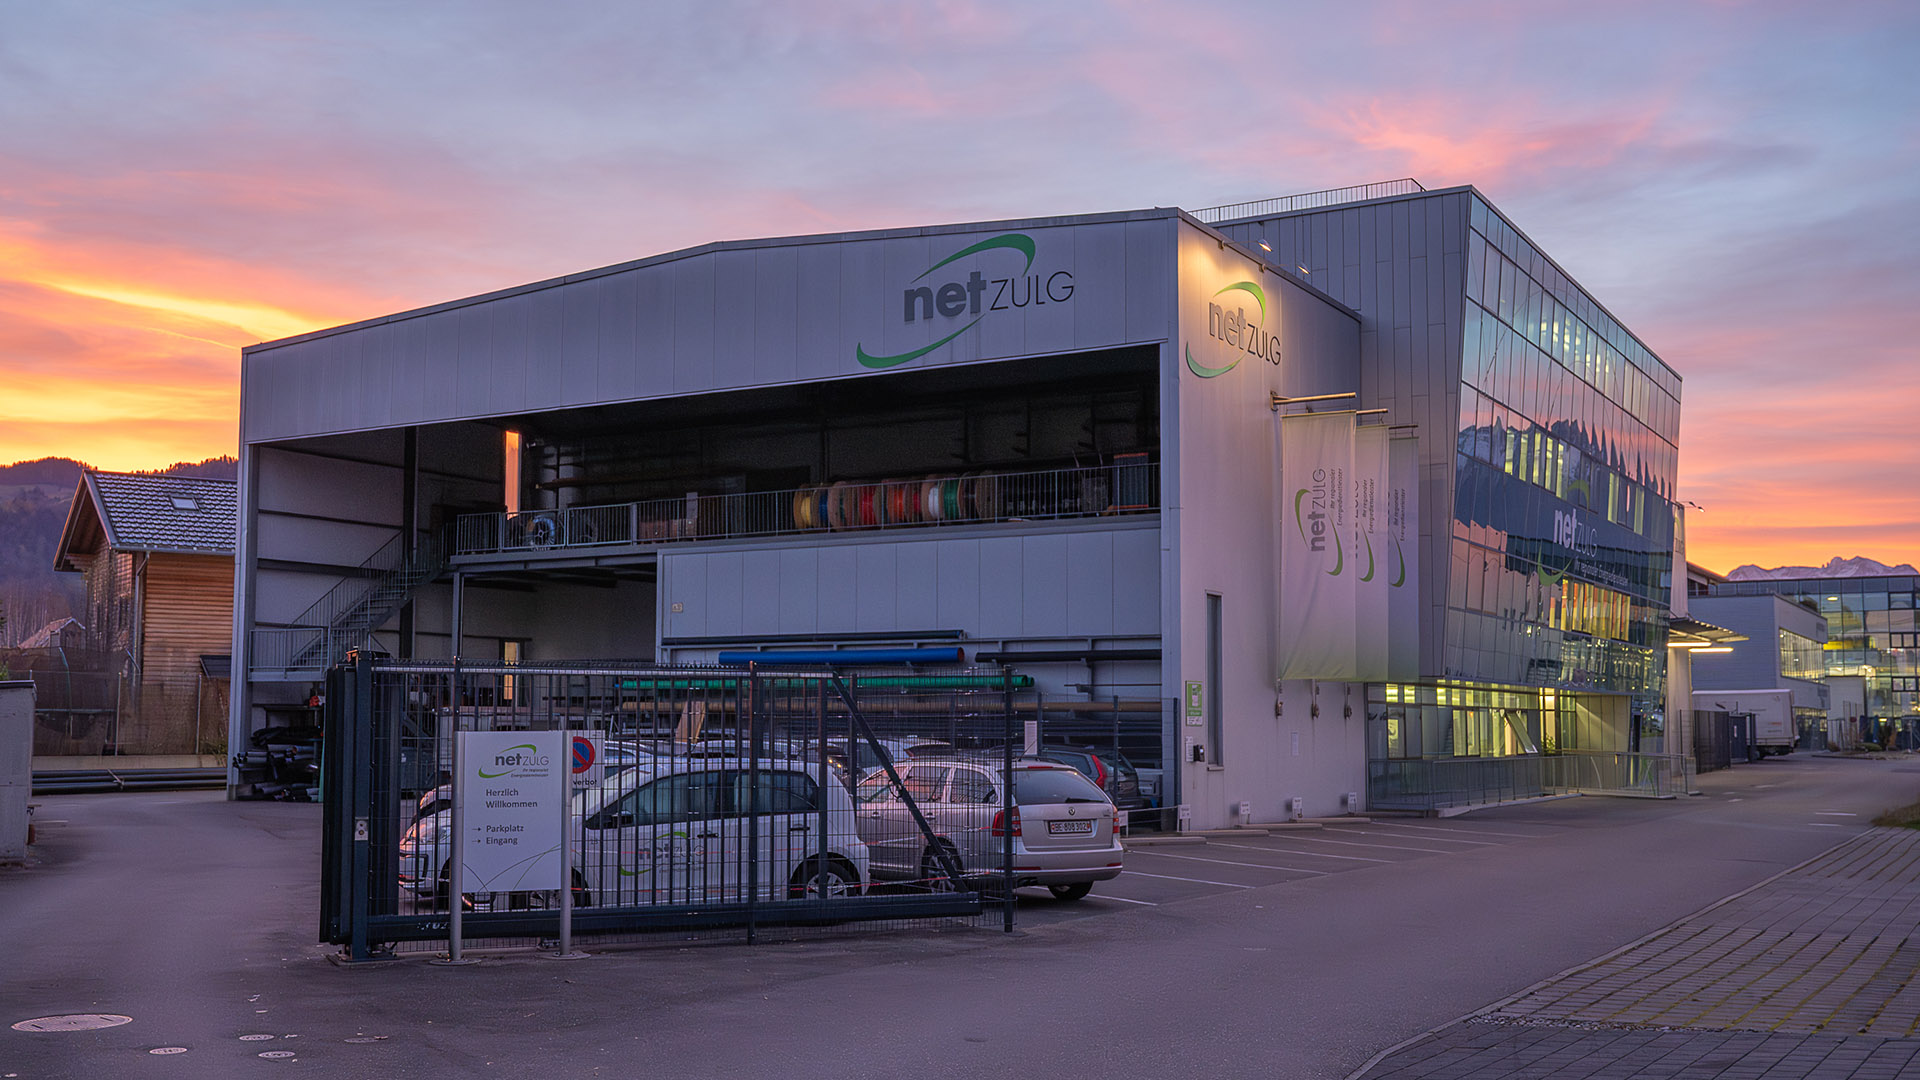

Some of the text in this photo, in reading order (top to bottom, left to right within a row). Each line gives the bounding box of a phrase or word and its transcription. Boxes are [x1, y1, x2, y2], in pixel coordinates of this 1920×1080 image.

[485, 788, 519, 797] Herzlich
[485, 800, 538, 808] Willkommen
[486, 824, 525, 834] Parkplatz
[486, 836, 518, 846] Eingang
